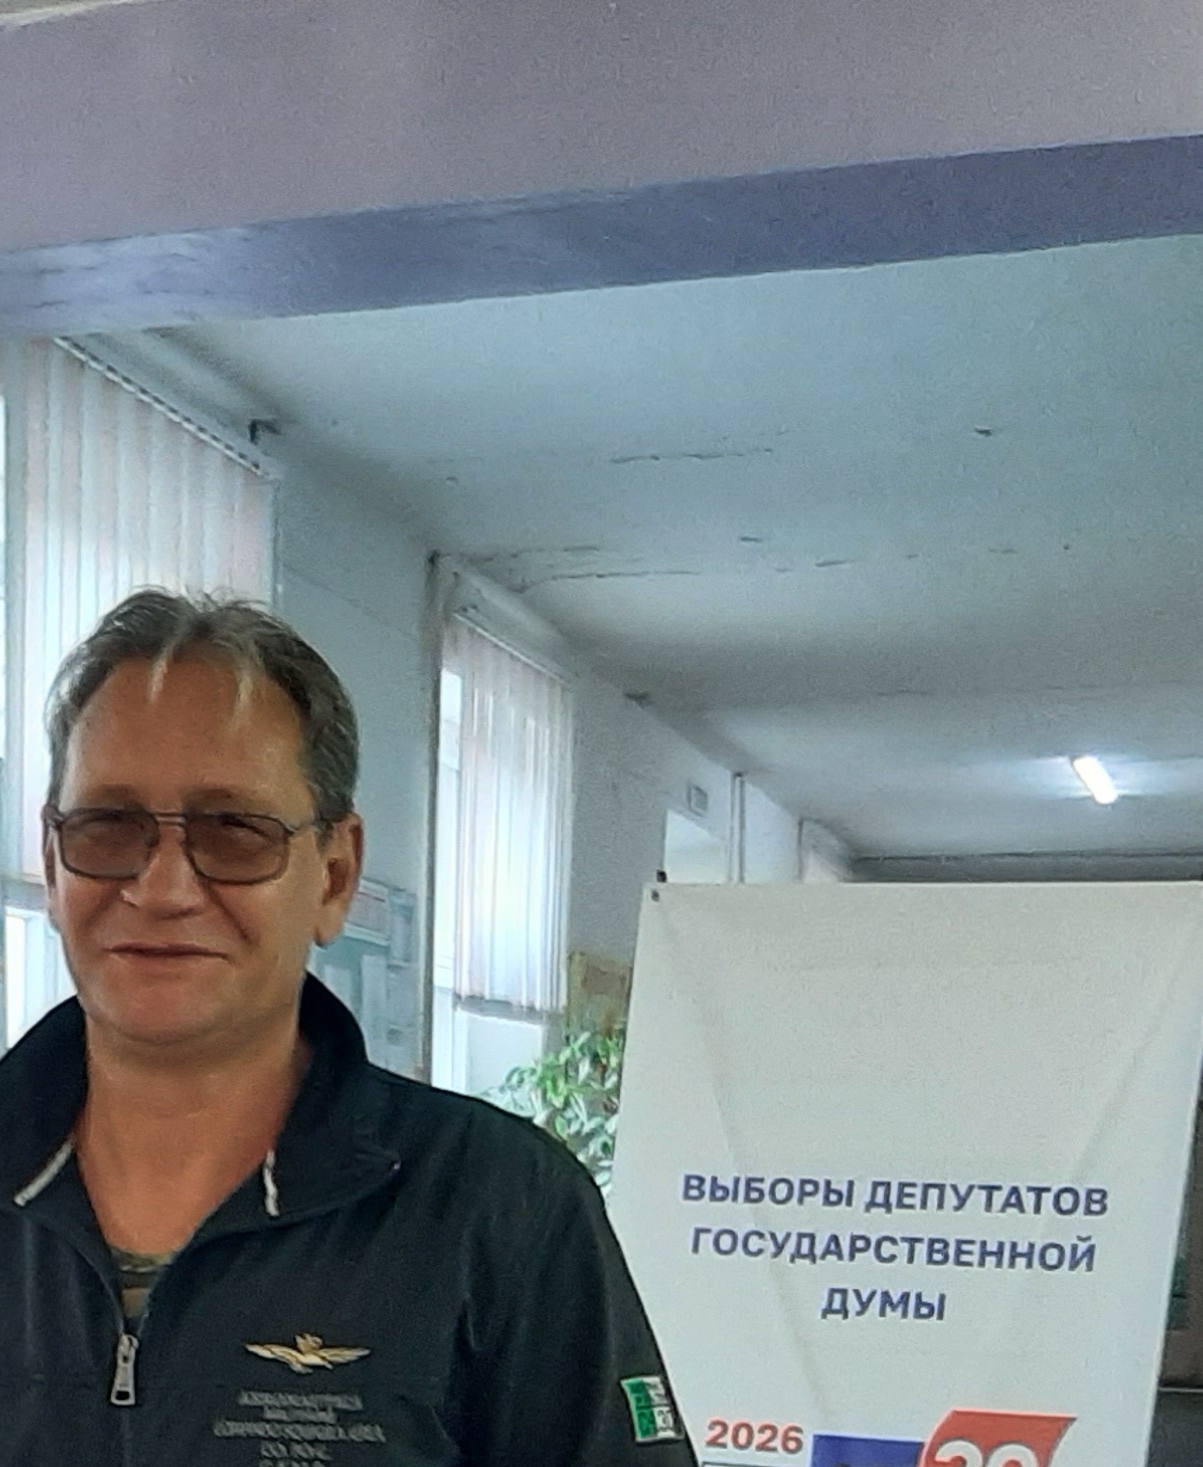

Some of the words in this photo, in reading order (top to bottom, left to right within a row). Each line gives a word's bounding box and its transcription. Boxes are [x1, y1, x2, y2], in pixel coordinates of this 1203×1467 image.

[682, 1174, 855, 1207] ВЫБОРЫ
[863, 1180, 1109, 1216] ДЕПУТАТОВ
[691, 1226, 1097, 1272] ГОСУДАРСТВЕННОЙ
[820, 1287, 947, 1321] ДУМЫ
[705, 1419, 804, 1454] 2026
